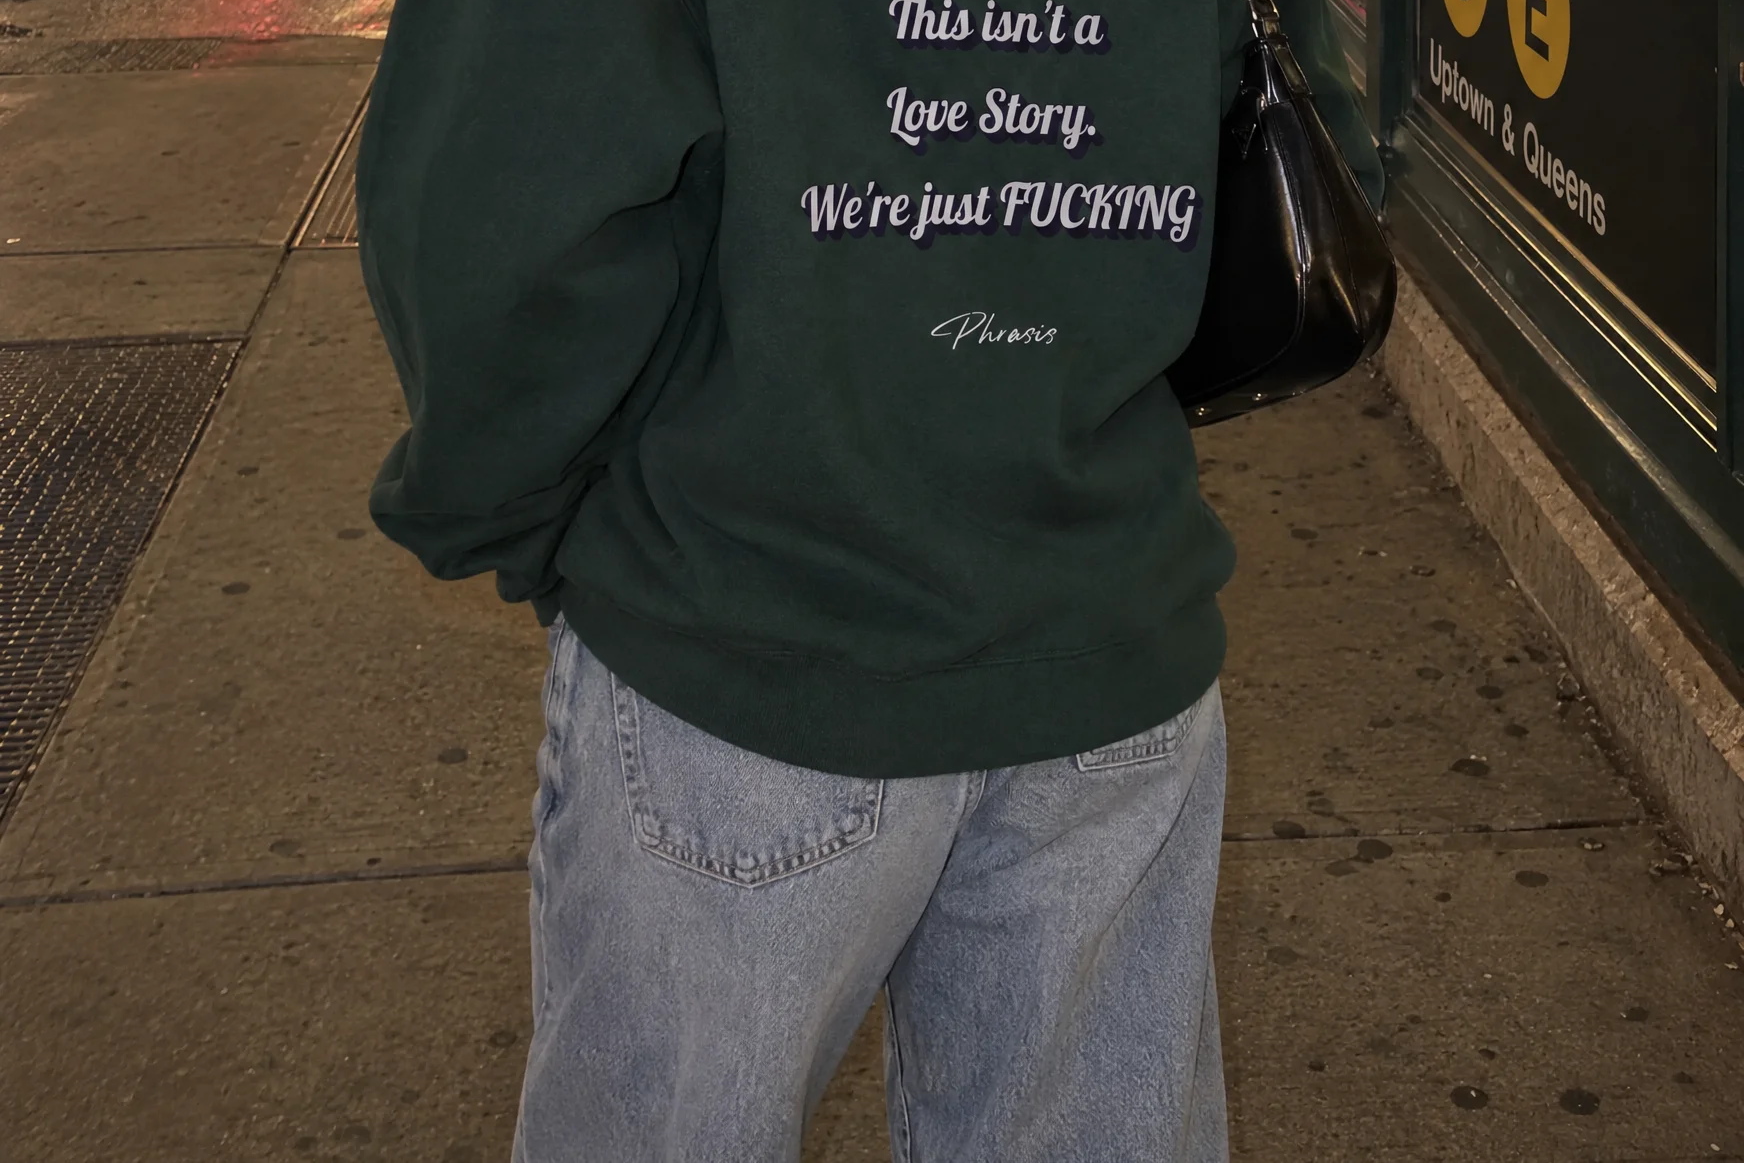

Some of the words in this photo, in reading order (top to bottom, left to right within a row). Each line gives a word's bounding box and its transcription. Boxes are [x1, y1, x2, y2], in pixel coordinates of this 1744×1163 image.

[981, 0, 1066, 44] isn't
[1073, 14, 1104, 45] a
[886, 86, 969, 146] Love
[978, 87, 1096, 150] Story.
[1430, 37, 1494, 136] Uptown
[1502, 103, 1515, 156] &
[1523, 121, 1606, 235] Queens
[800, 181, 911, 233] We're
[909, 181, 991, 241] just
[1000, 181, 1196, 243] FUCKING
